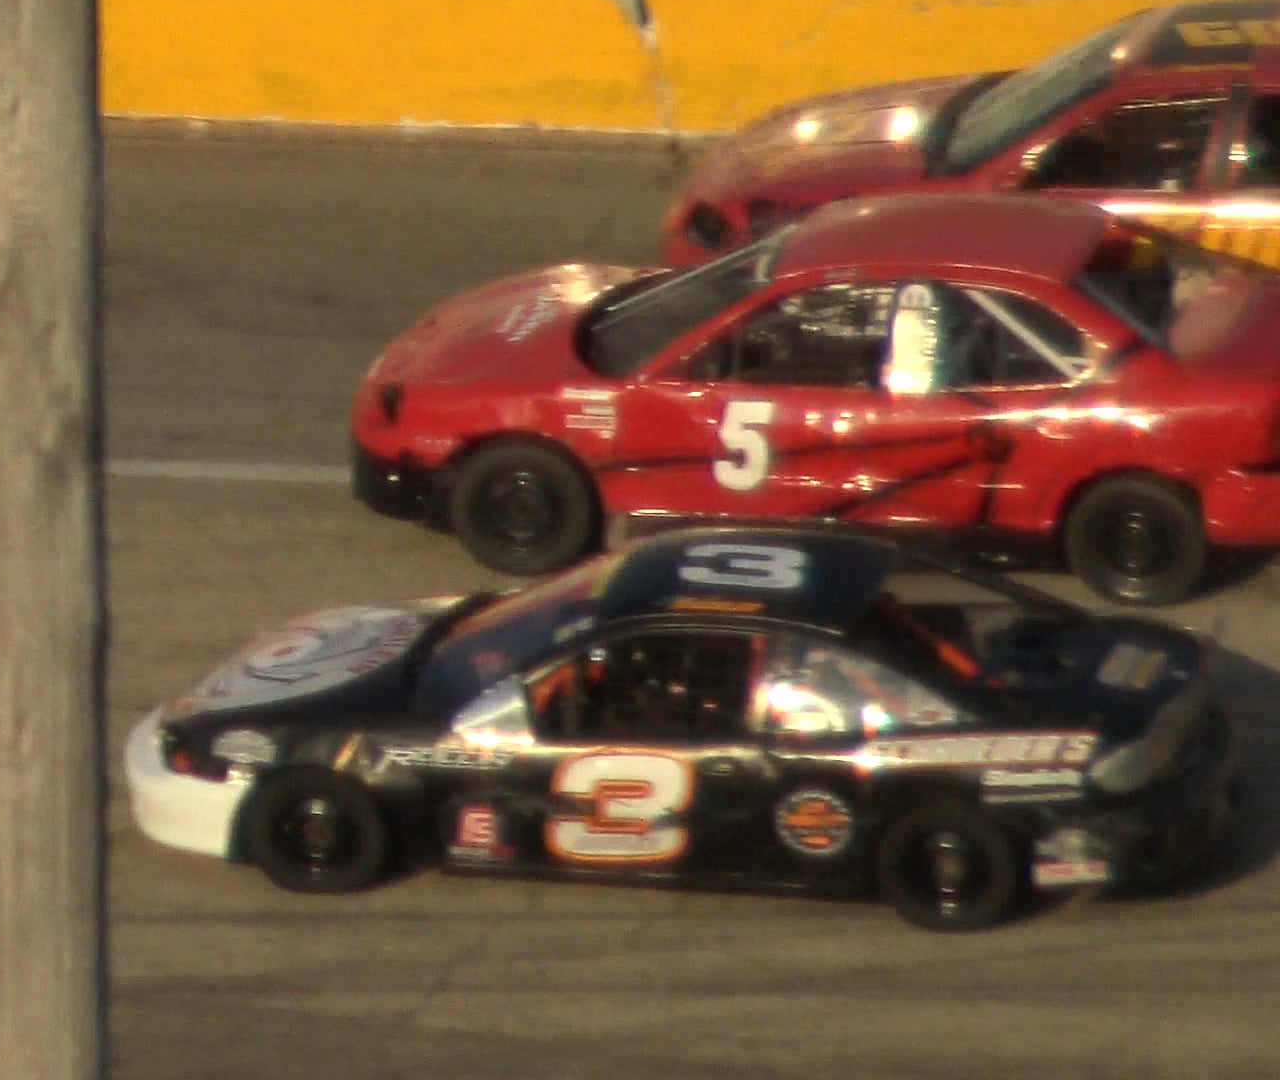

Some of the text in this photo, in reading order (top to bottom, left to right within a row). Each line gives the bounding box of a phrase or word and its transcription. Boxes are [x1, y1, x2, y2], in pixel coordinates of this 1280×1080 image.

[713, 399, 776, 493] 5
[678, 541, 809, 590] 3
[544, 747, 697, 863] 3
